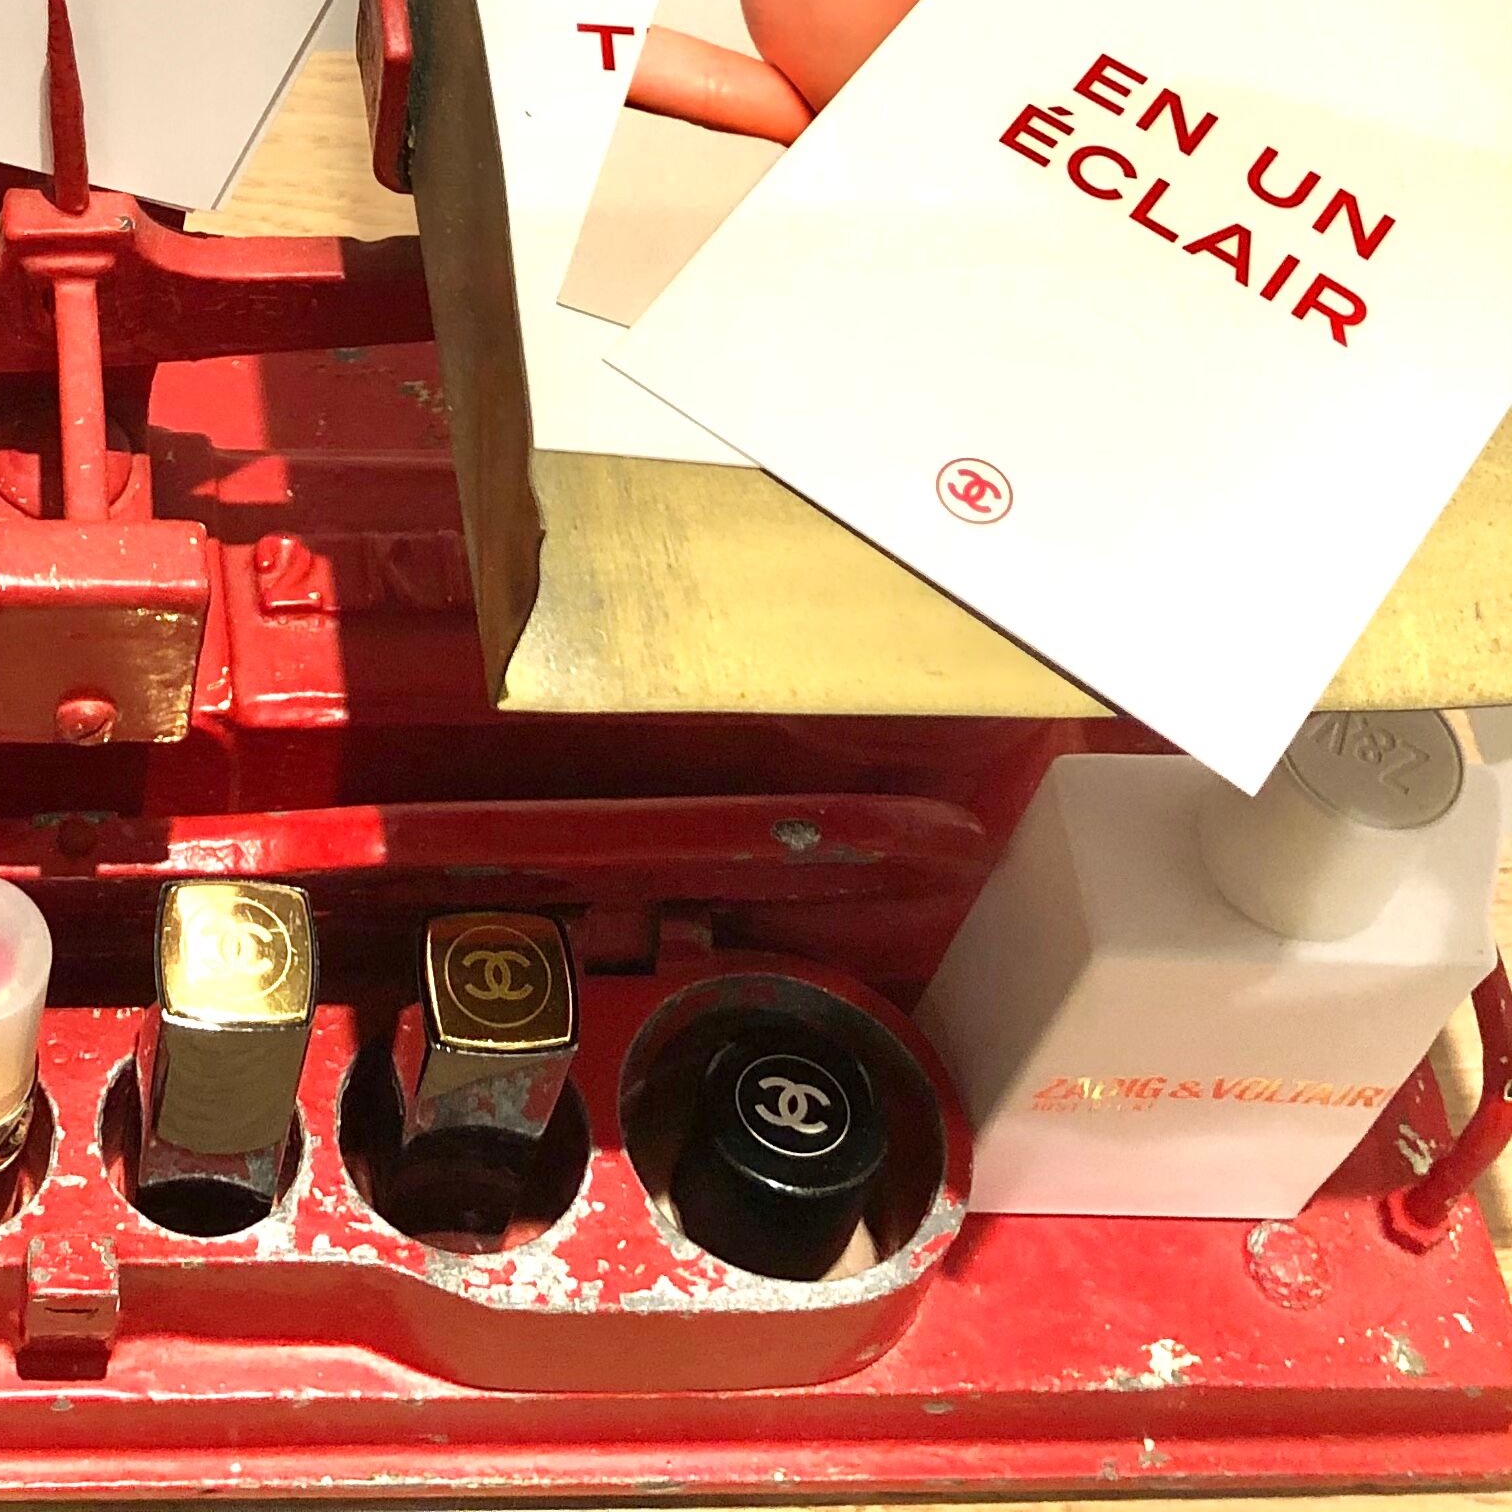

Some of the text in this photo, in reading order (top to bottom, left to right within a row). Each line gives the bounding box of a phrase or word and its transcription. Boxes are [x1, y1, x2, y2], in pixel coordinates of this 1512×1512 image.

[575, 22, 650, 72] T
[998, 103, 1369, 348] ÉCLAIR
[1072, 52, 1397, 262] EN UN
